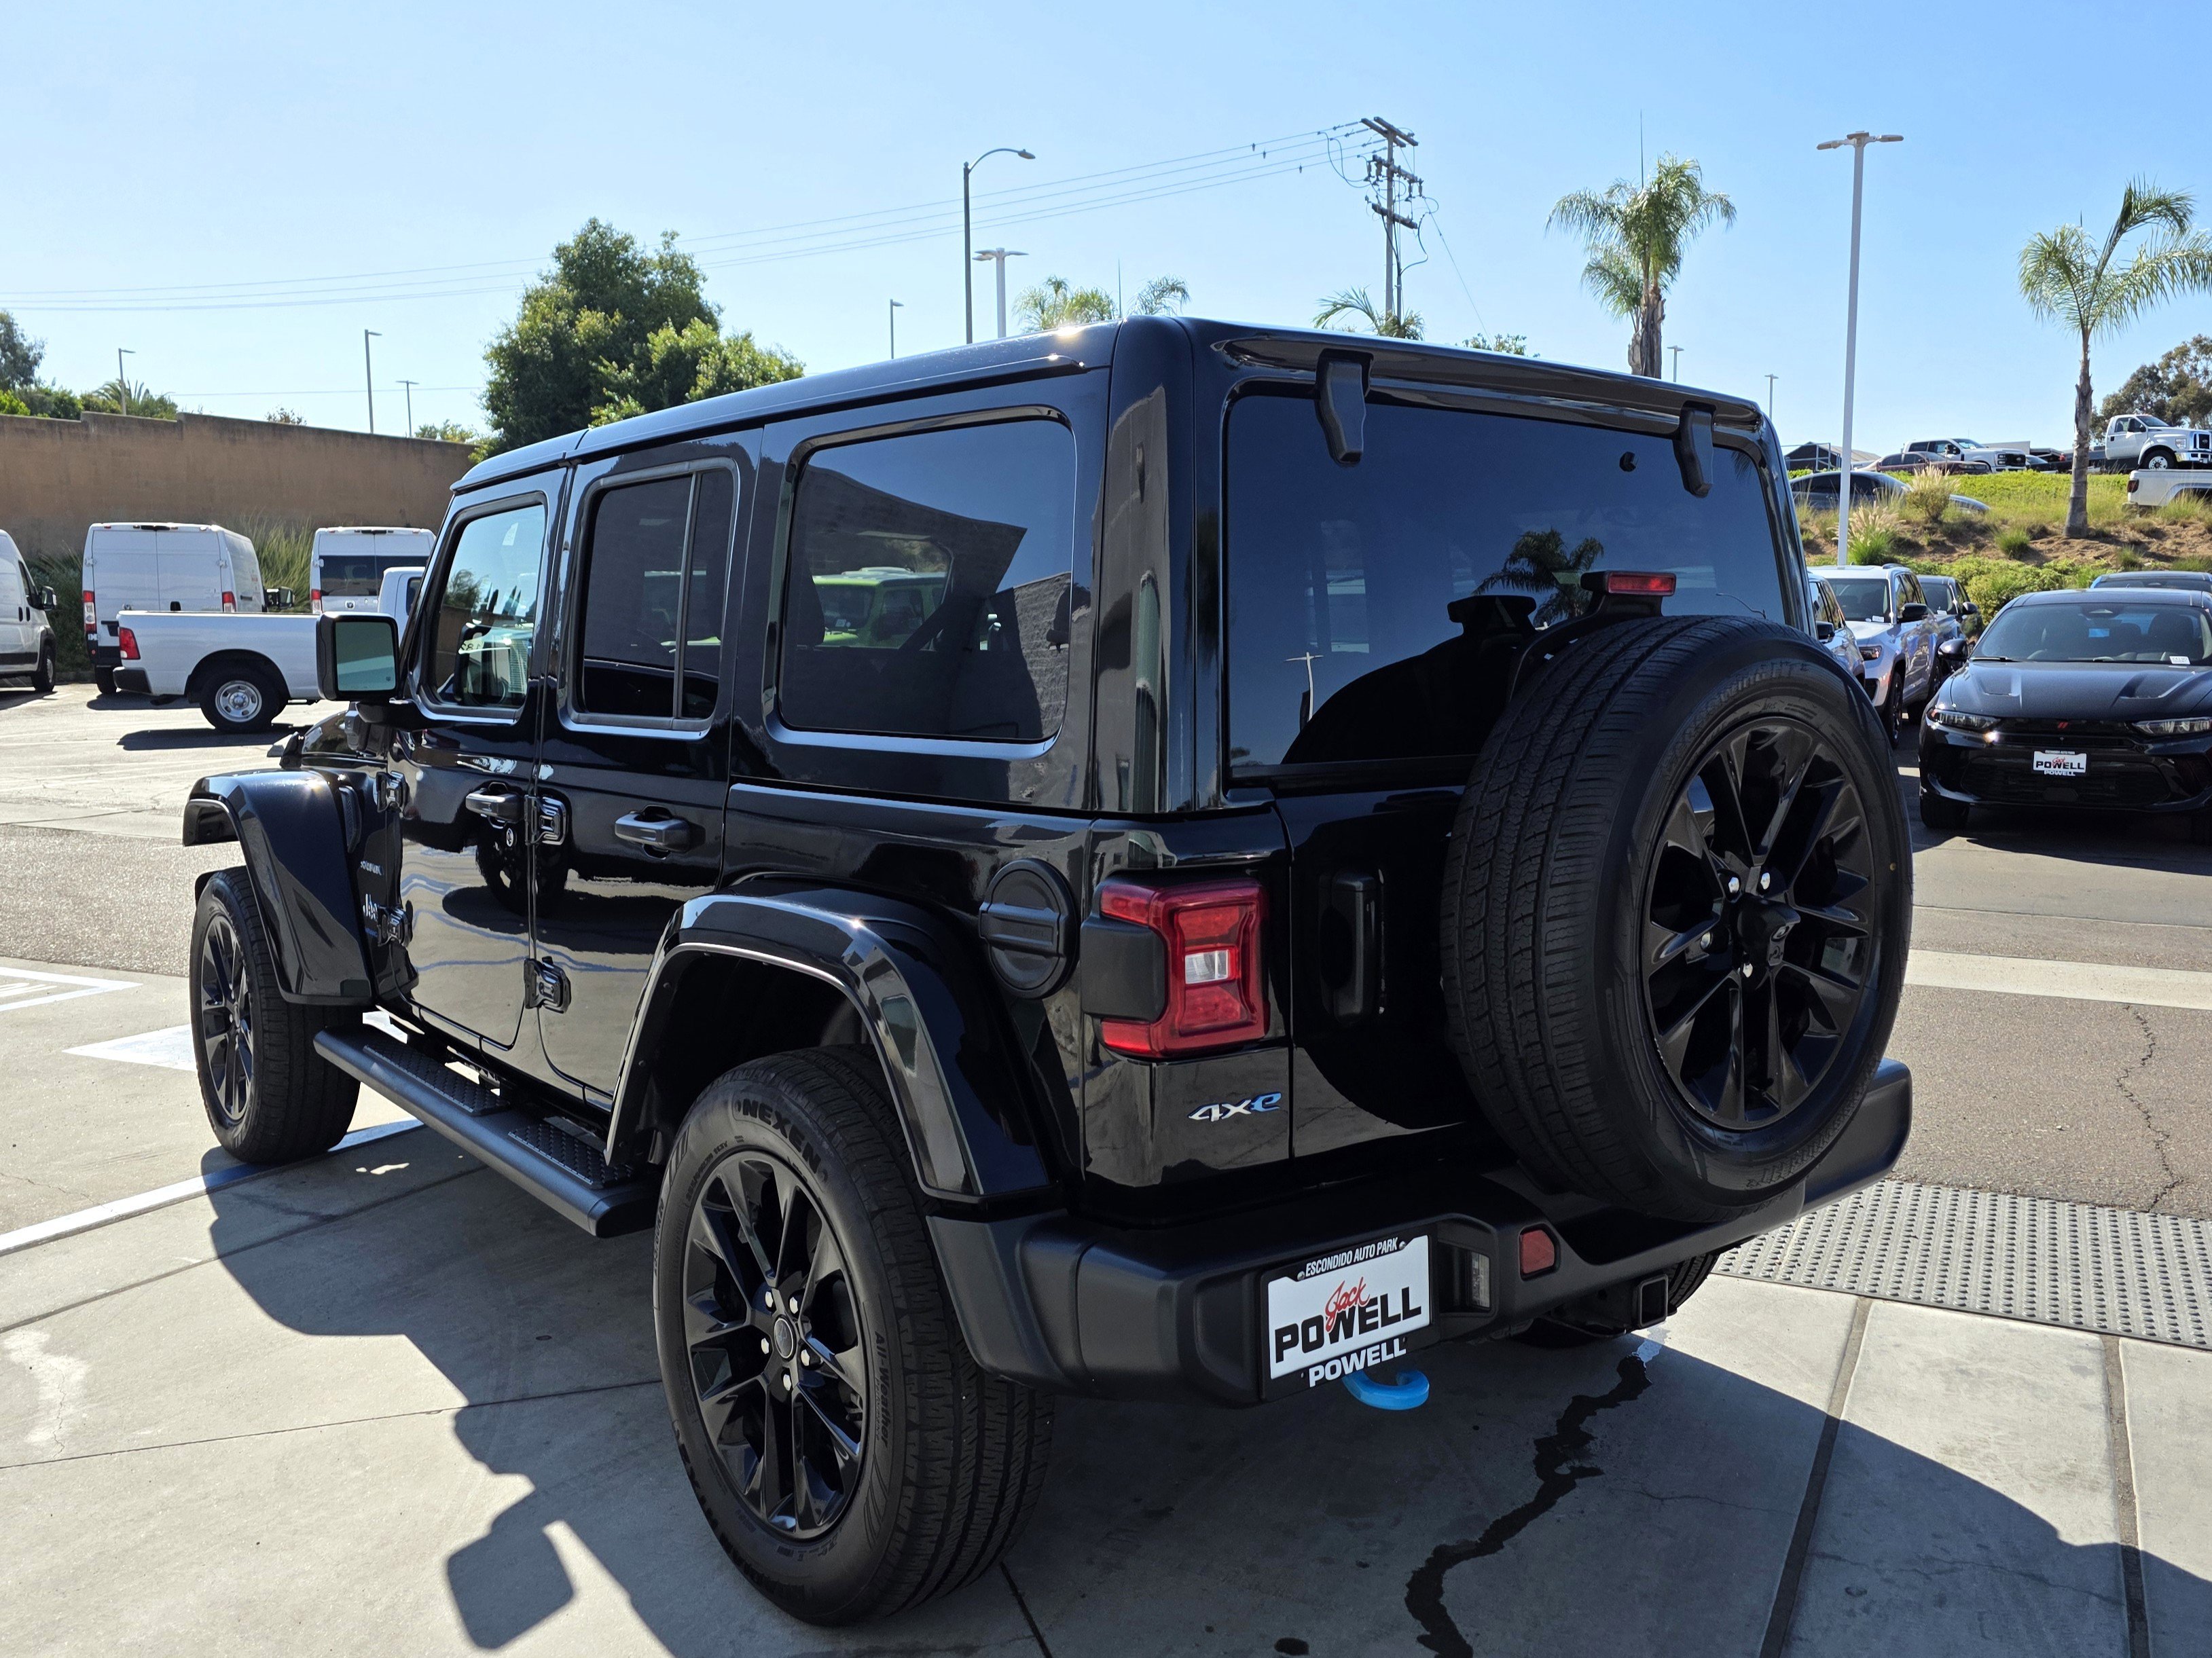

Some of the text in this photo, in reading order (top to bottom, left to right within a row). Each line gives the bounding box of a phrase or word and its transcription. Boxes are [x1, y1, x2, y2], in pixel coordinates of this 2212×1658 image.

[2035, 760, 2084, 770] POWELL
[742, 1098, 822, 1174] NEXEN
[1305, 1237, 1398, 1277] ESCONDIDO AUTO PARK
[1274, 1287, 1422, 1363] POWELL
[1325, 1276, 1371, 1332] Jack
[874, 1331, 892, 1448] All-Weather
[1308, 1338, 1407, 1388] POWELL
